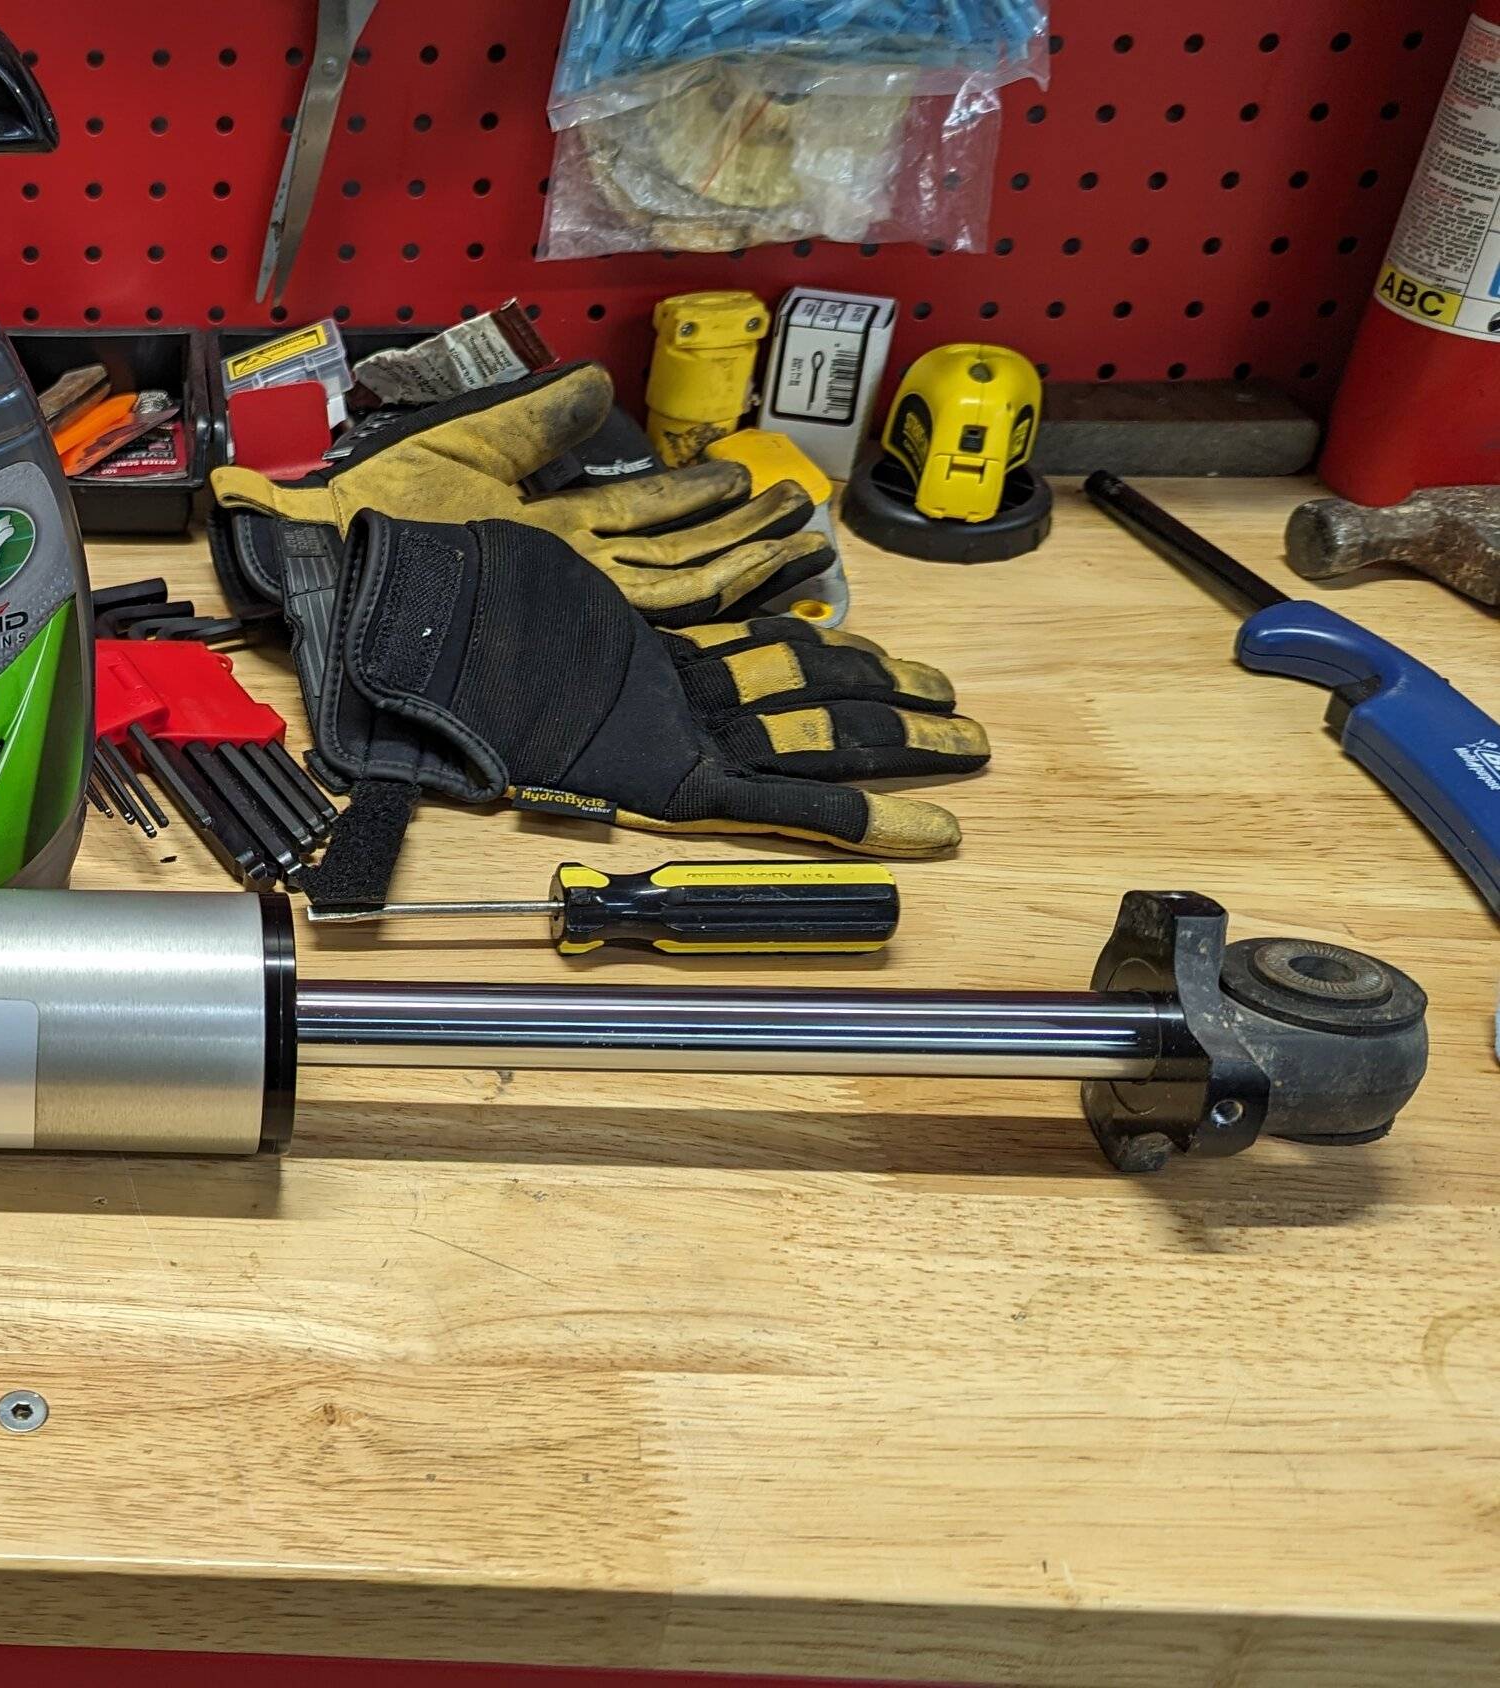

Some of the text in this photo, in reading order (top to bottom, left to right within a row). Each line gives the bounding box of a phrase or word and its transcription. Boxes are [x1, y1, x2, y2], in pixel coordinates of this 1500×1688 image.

[1380, 271, 1446, 317] ABC
[521, 790, 607, 808] HydroHyde
[581, 804, 612, 814] leather
